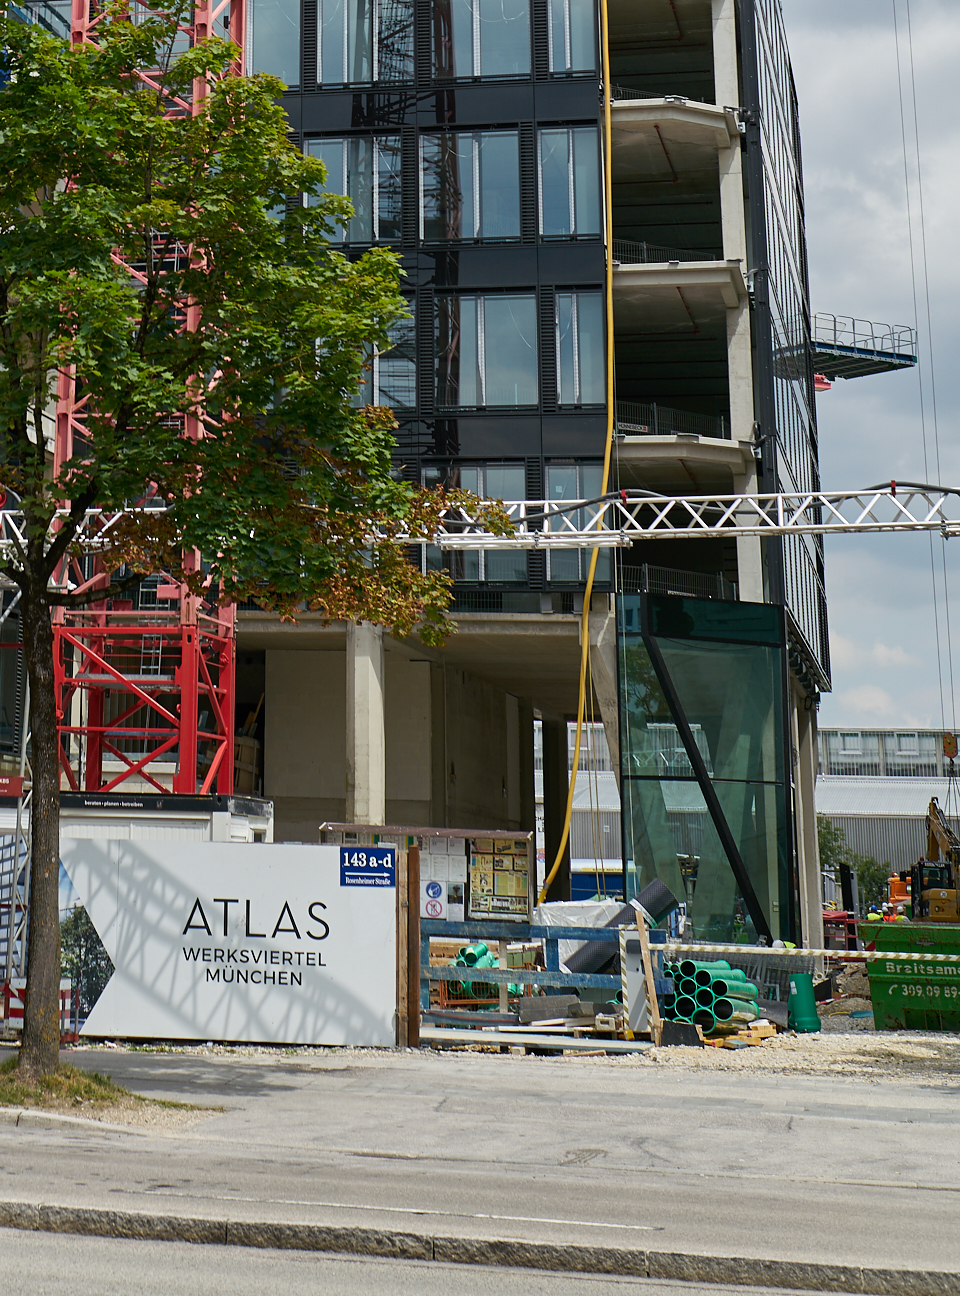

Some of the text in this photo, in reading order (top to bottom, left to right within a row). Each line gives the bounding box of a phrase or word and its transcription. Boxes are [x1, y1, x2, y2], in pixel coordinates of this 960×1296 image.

[343, 852, 393, 868] 143 a-d
[182, 897, 330, 940] ATLAS
[182, 947, 327, 967] WERKSVIERTEL
[206, 965, 302, 986] MÜNCHEN
